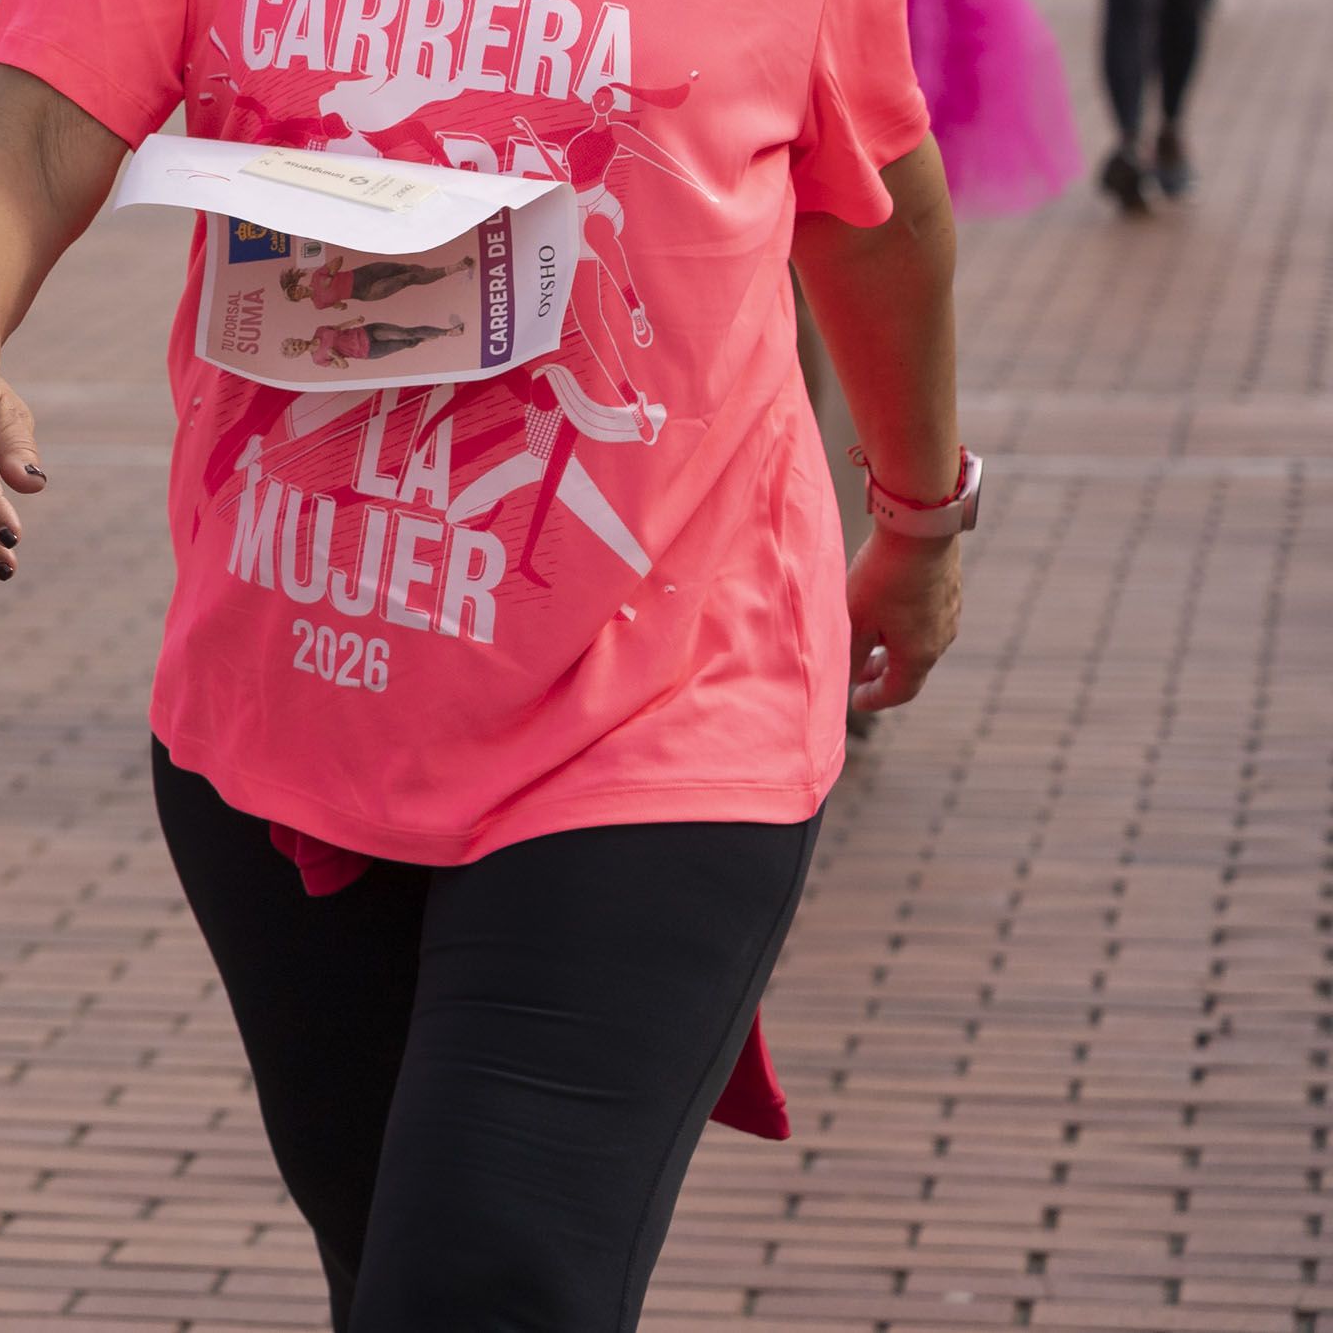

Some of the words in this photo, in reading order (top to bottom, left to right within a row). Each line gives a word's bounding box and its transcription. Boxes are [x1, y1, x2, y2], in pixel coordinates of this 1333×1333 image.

[487, 231, 506, 259] DE
[223, 289, 241, 337] DORSAL
[489, 263, 509, 356] CARRERA
[537, 245, 556, 318] OYSHO
[221, 338, 236, 352] TU
[236, 286, 265, 355] SUMA
[227, 464, 508, 645] MUJER
[291, 618, 392, 694] 2026
